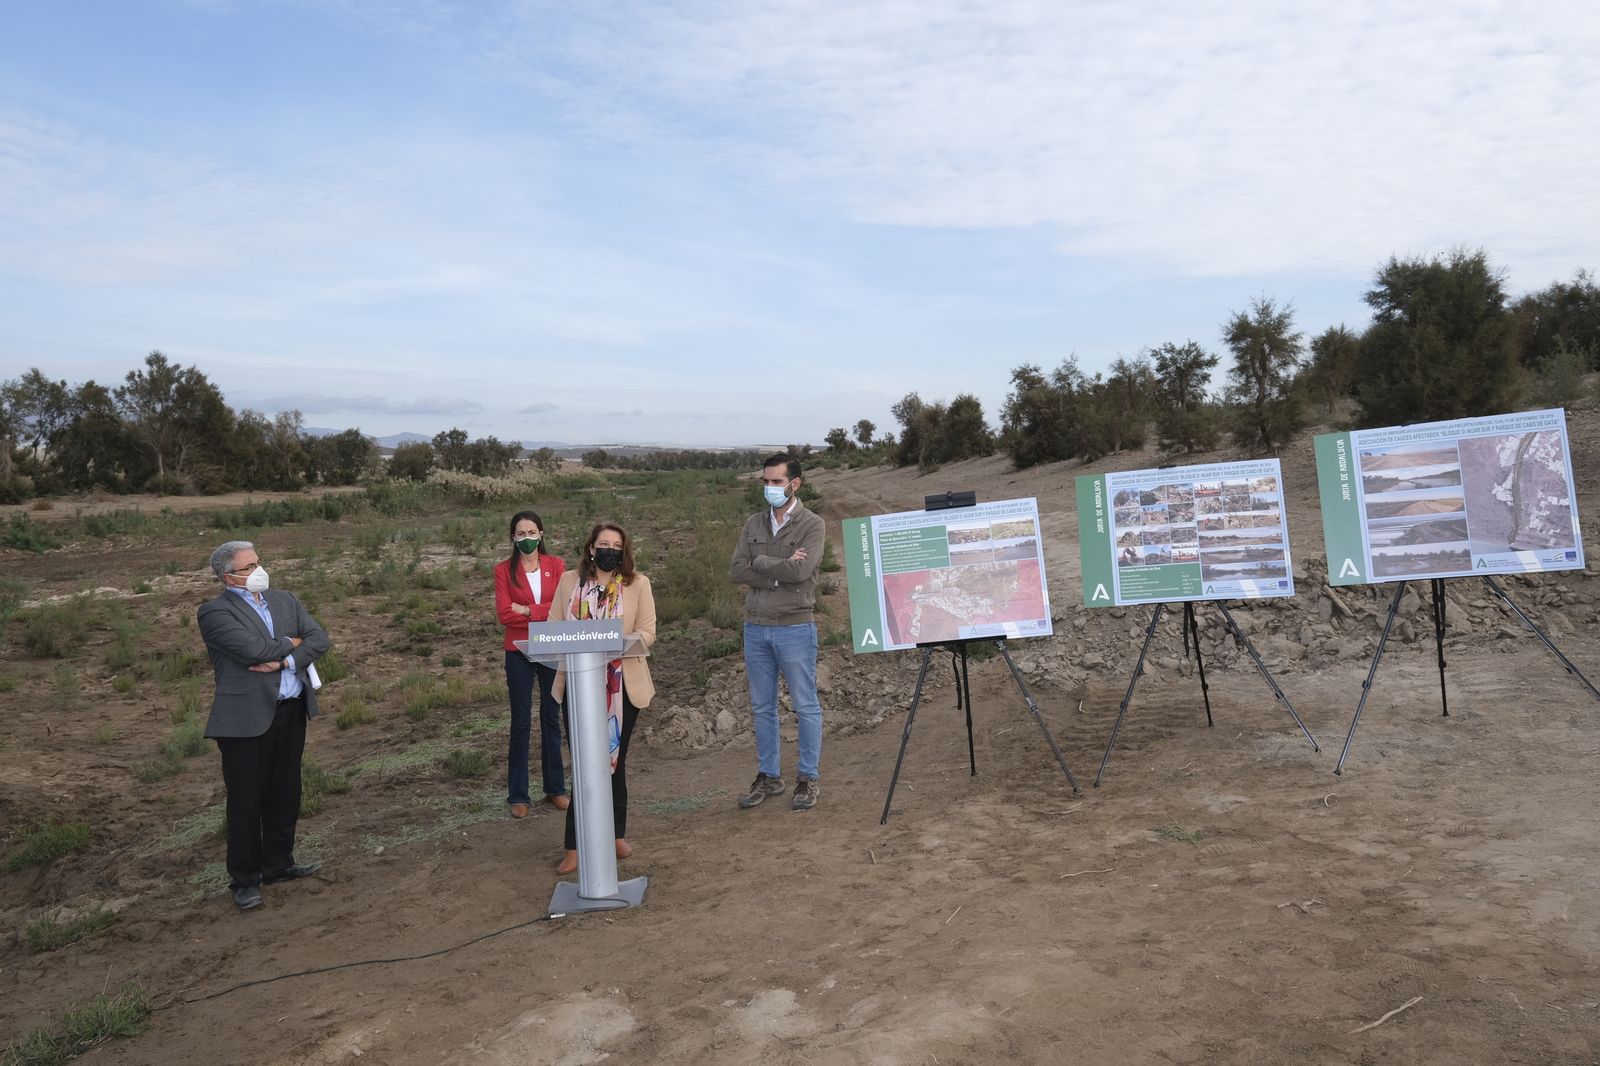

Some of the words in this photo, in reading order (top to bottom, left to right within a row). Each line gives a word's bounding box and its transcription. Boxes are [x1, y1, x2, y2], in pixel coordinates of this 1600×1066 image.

[1413, 432, 1439, 440] AFECTADOS
[1342, 483, 1351, 501] JUNTA
[533, 631, 619, 642] #RevoluciónVerde
